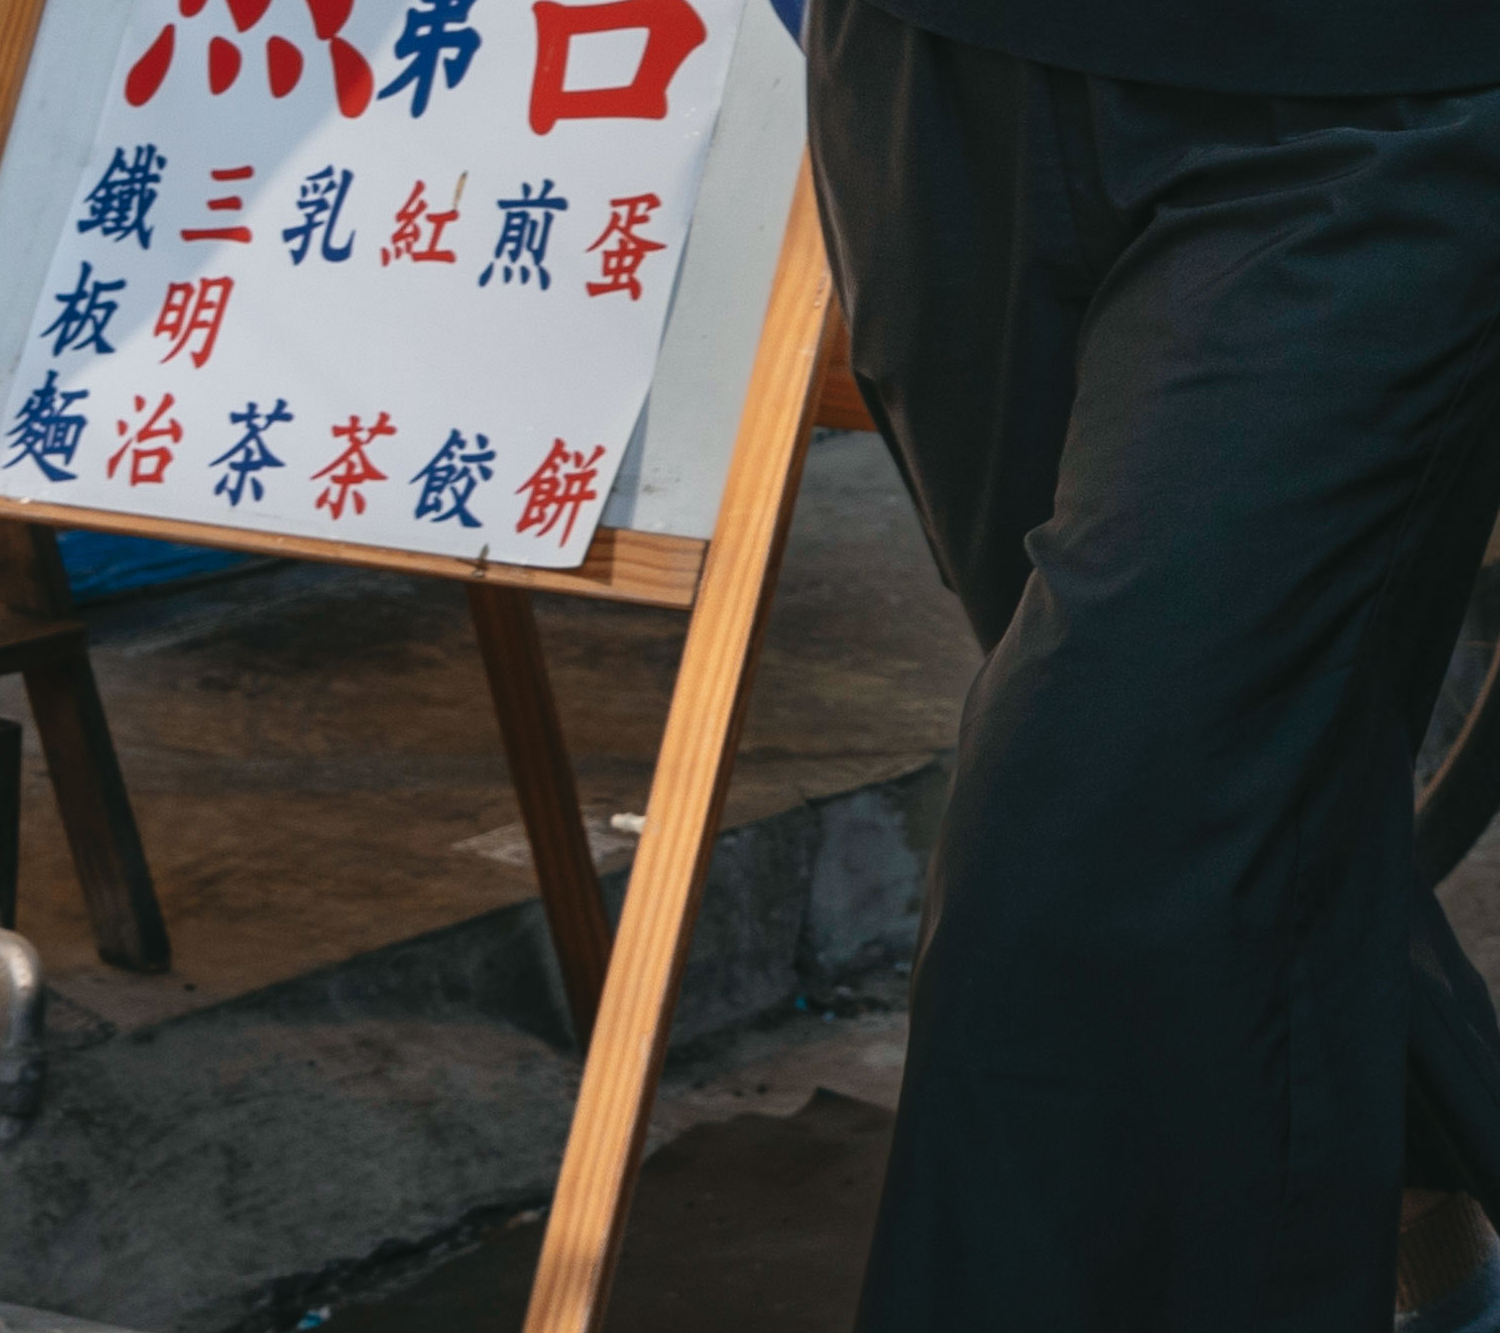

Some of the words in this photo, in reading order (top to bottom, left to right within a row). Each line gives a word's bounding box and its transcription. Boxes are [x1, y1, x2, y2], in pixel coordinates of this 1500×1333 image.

[2, 144, 167, 482] 鐵板麵
[106, 165, 255, 487] 三明治
[208, 165, 356, 507] 乳茶
[311, 180, 459, 520] 紅茶
[410, 179, 569, 528] 煎餃
[514, 192, 668, 547] 蛋餅
